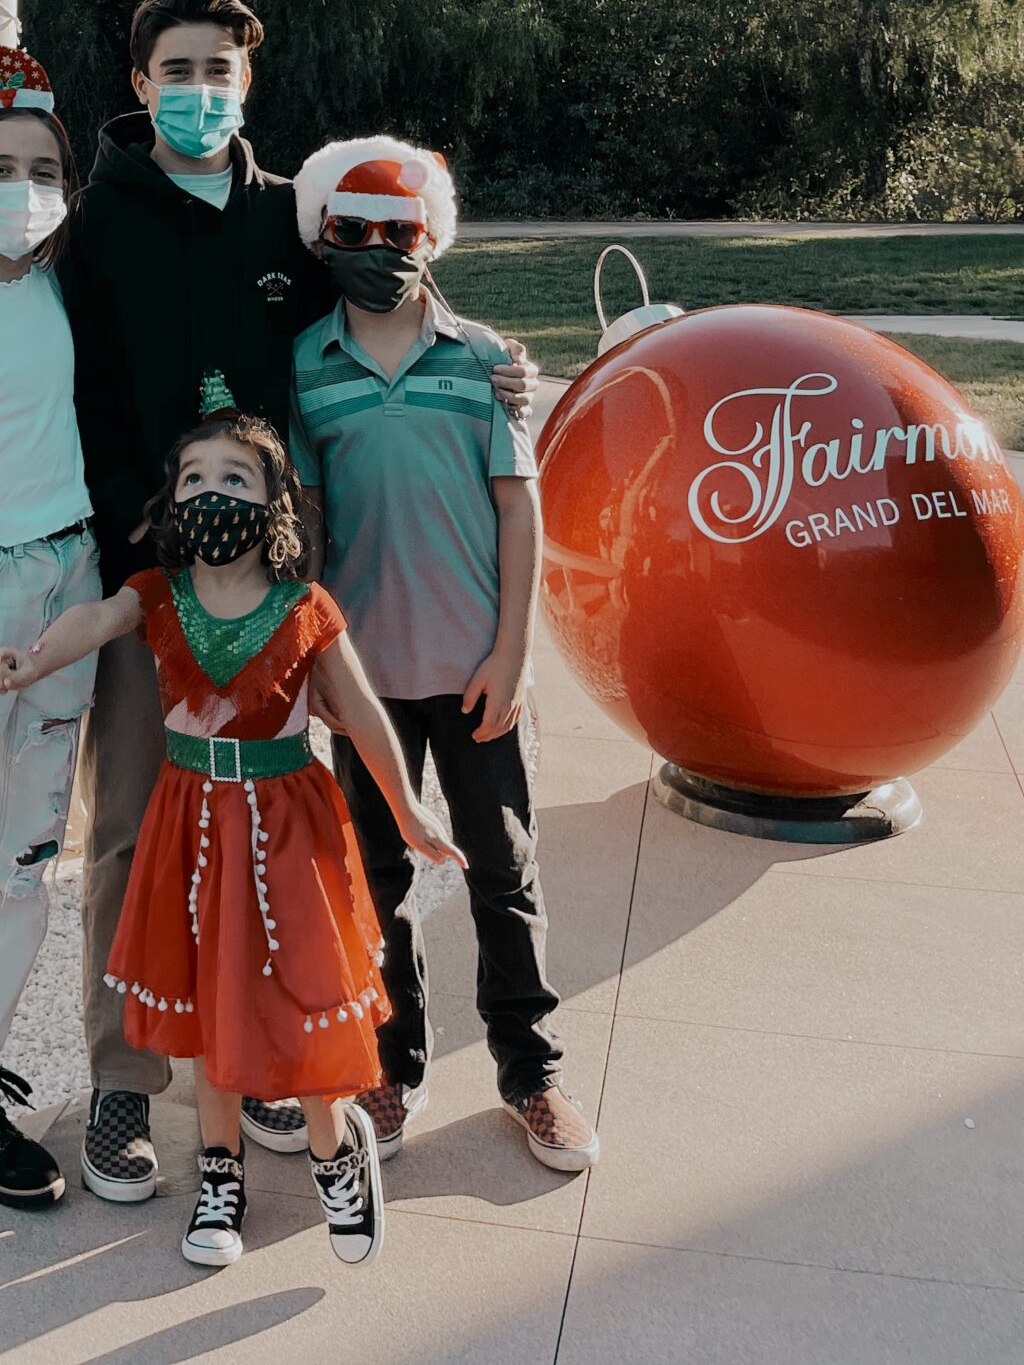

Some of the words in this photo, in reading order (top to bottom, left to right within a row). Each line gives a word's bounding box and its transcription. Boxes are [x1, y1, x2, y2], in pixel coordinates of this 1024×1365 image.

[256, 272, 276, 287] DARK
[785, 497, 901, 548] GRAND
[911, 490, 967, 521] DEL
[970, 489, 1012, 515] MAR
